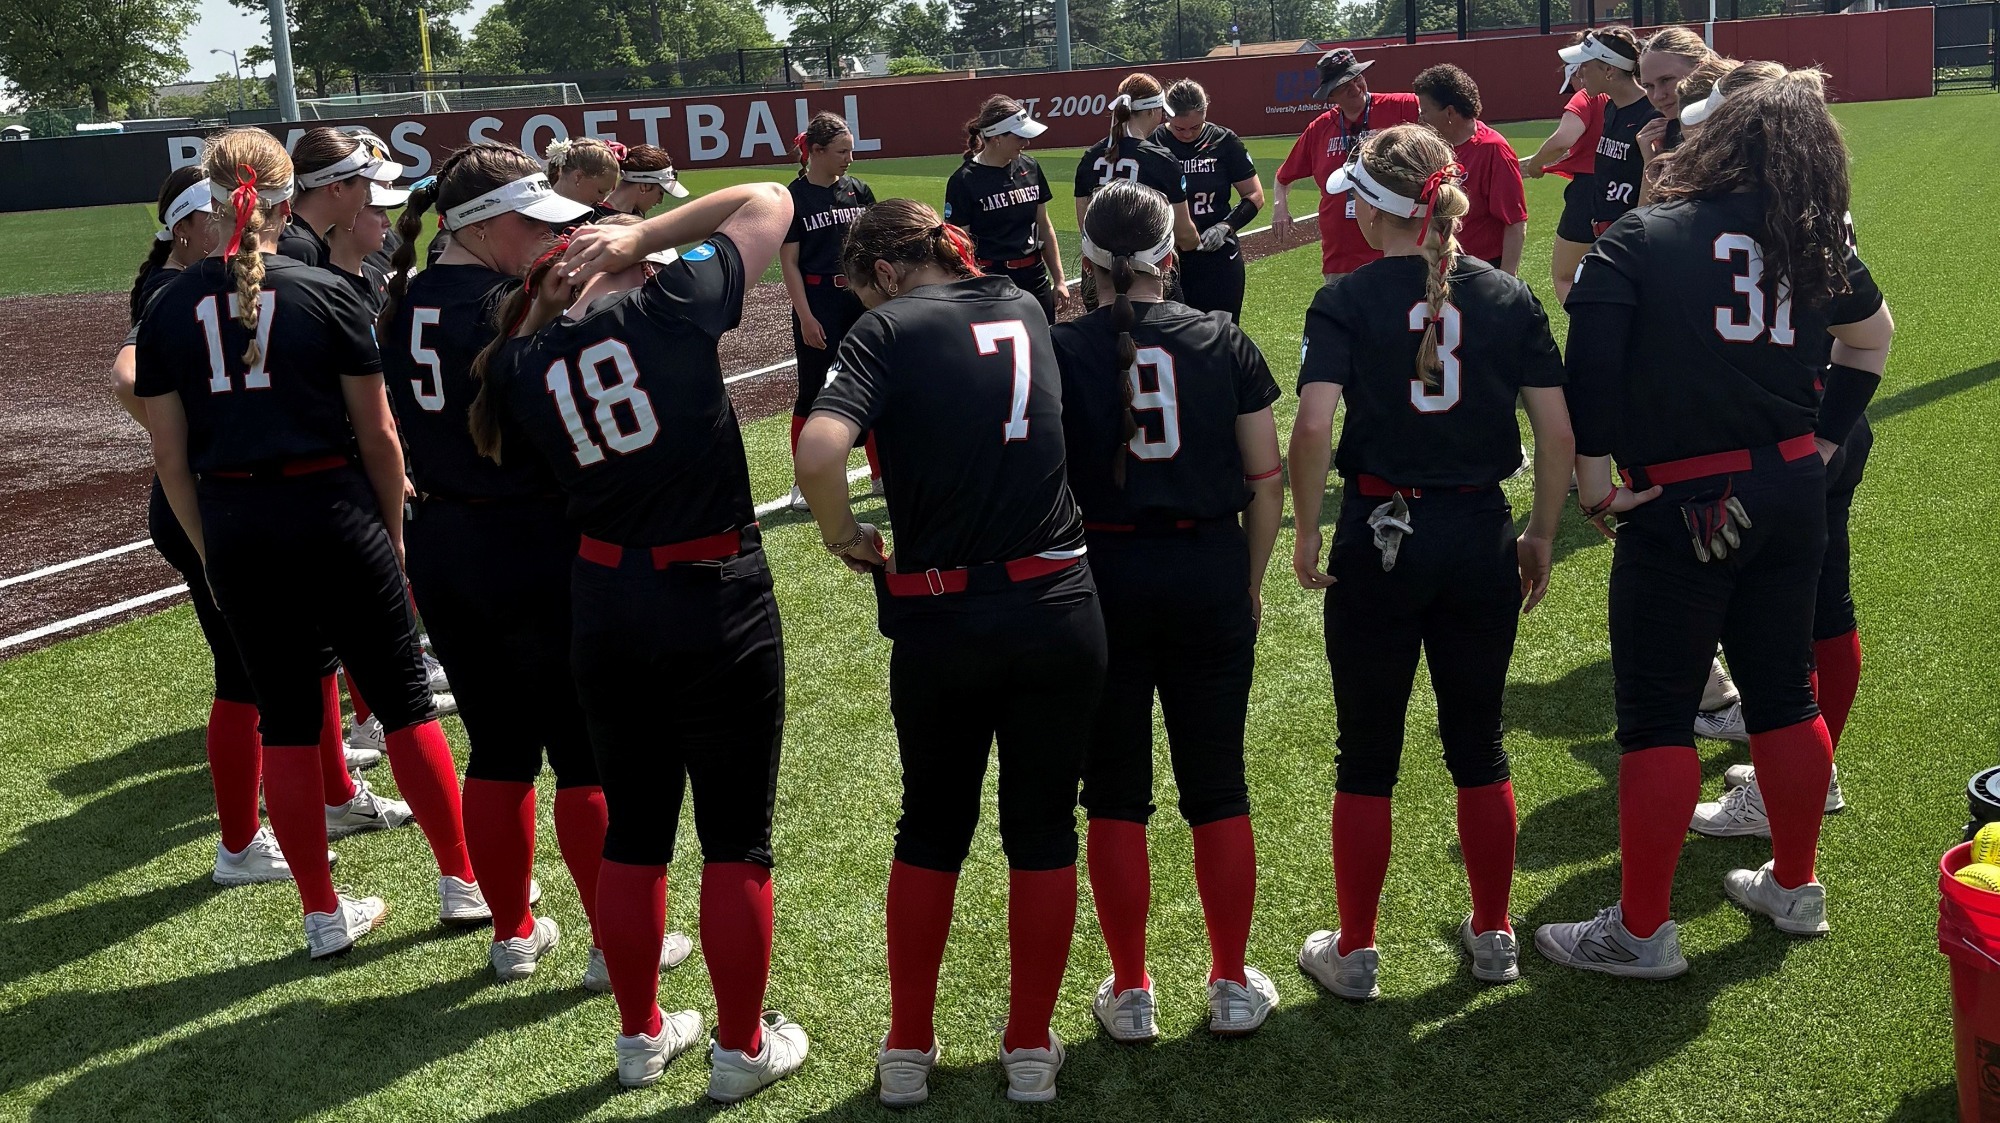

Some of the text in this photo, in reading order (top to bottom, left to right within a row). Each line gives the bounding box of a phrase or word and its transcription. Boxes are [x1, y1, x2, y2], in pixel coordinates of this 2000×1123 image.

[1047, 94, 1107, 117] 2000
[1265, 105, 1297, 114] University
[1297, 103, 1321, 112] Athletic
[803, 206, 866, 232] LAKE FORE
[979, 185, 1040, 211] LAKE FOREST
[1179, 158, 1218, 174] OREST
[1194, 192, 1215, 215] 21
[195, 289, 276, 395] 17
[1712, 232, 1796, 347] 31
[410, 306, 446, 413] 5
[544, 337, 661, 468] 18
[970, 319, 1032, 445] 7
[1129, 345, 1181, 462] 9
[1407, 300, 1463, 414] 3
